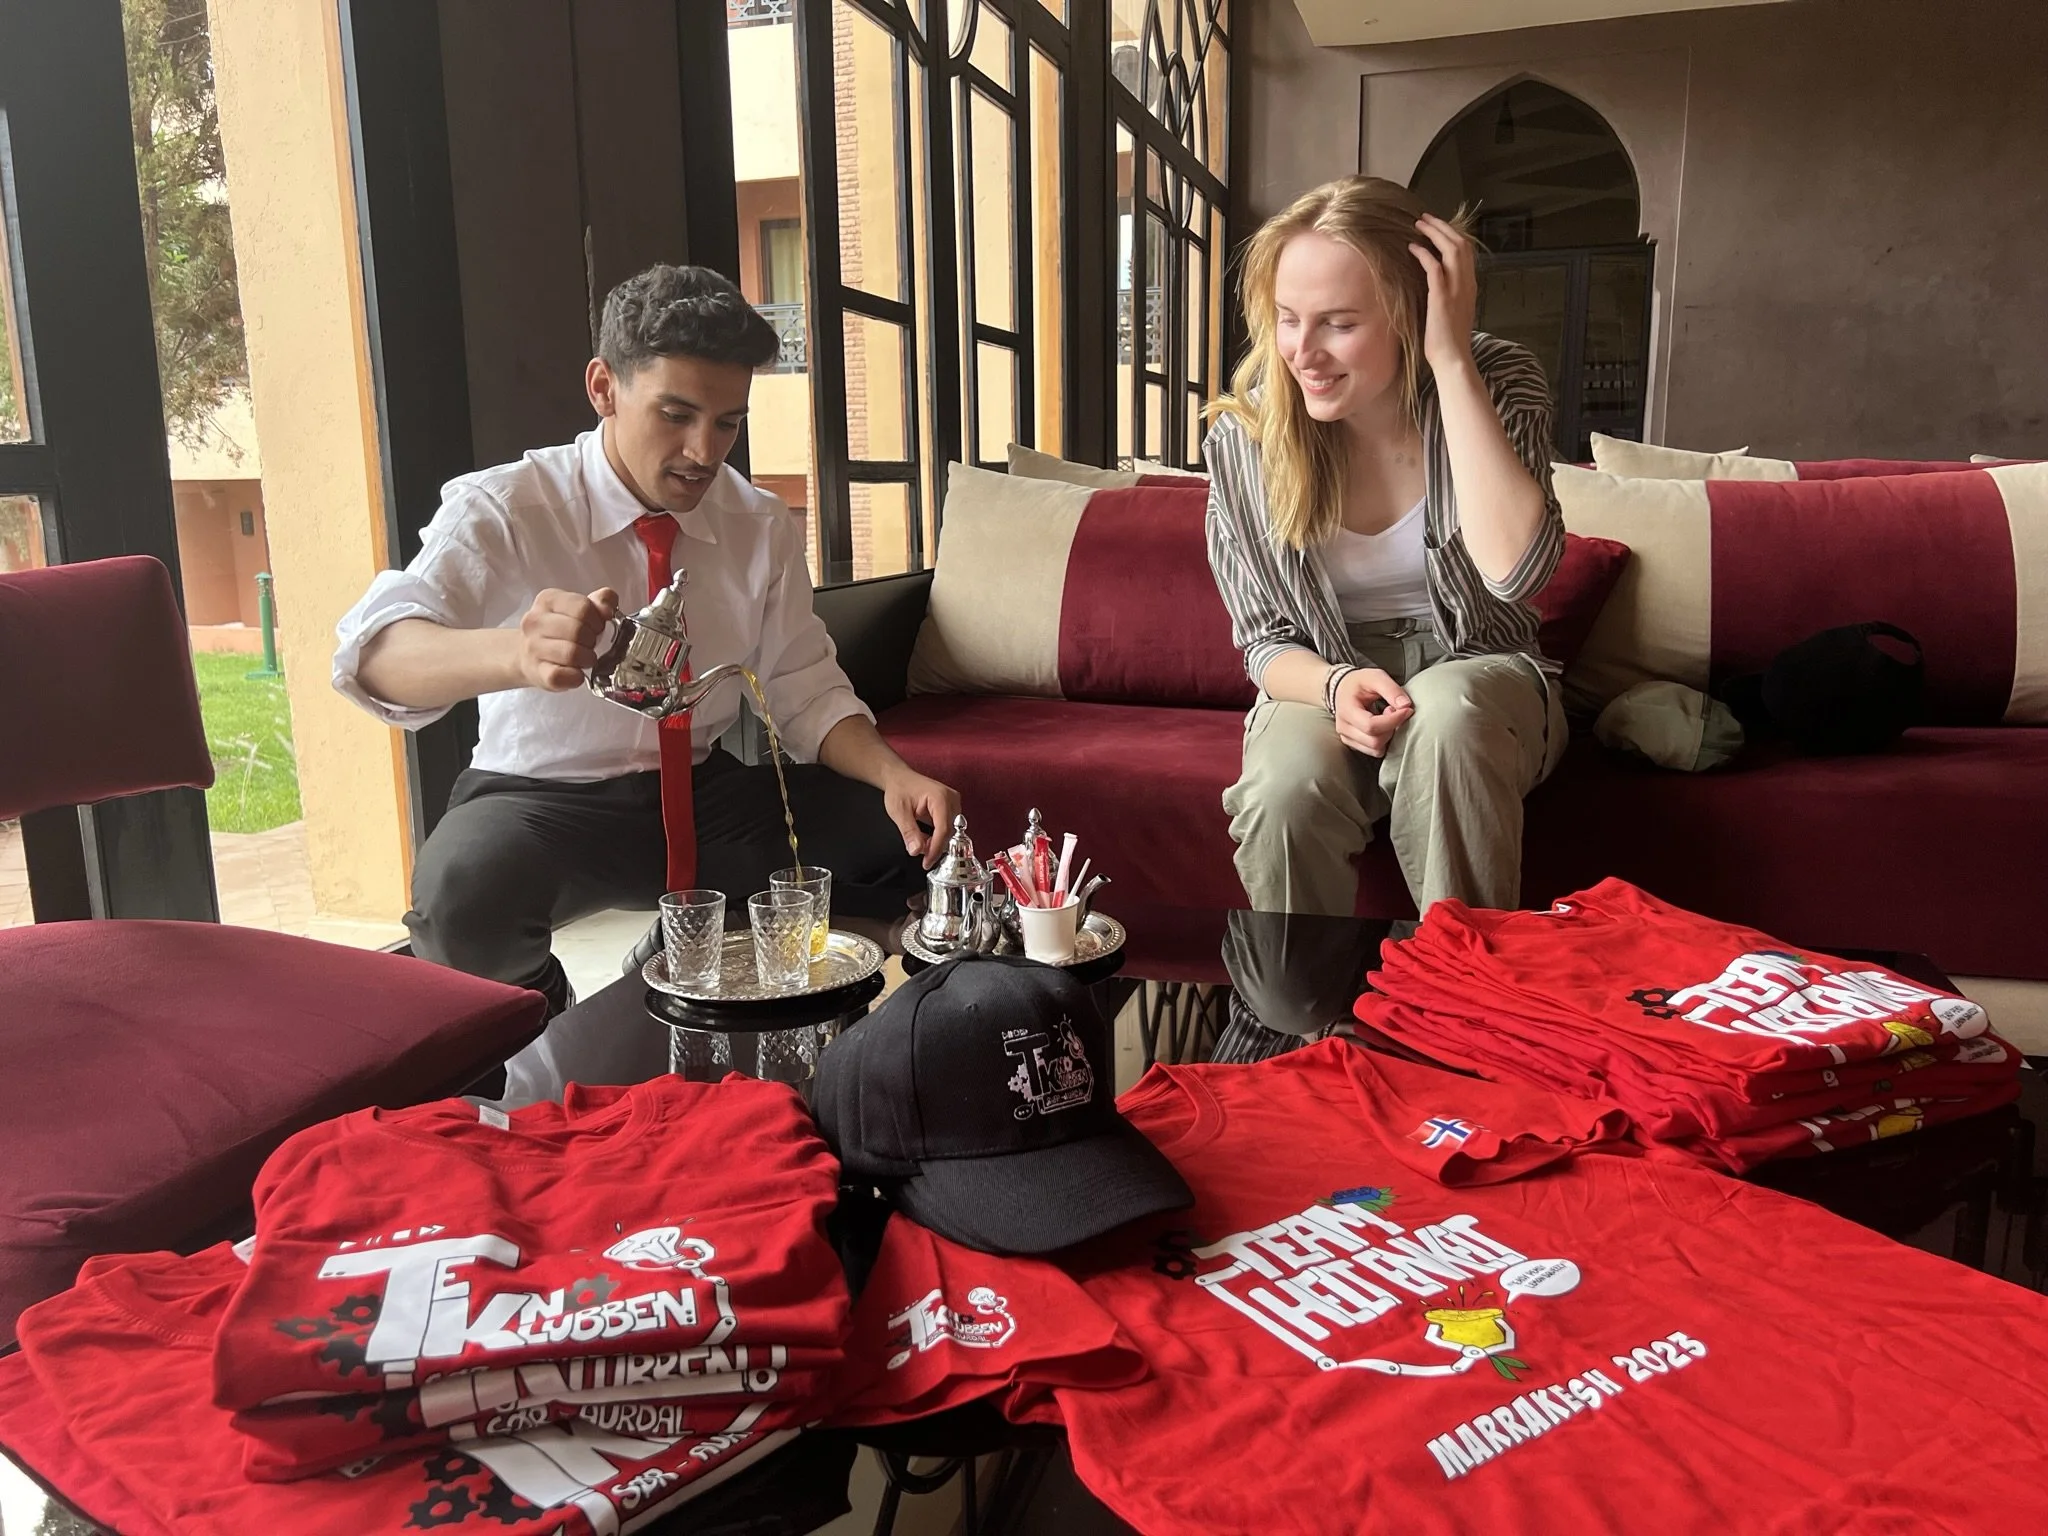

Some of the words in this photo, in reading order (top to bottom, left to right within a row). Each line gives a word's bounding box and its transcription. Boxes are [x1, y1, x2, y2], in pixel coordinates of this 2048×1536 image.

[1191, 1202, 1406, 1280] TEAM
[579, 1404, 695, 1435] AURDAL
[1425, 1368, 1624, 1480] MARRAKESH
[1611, 1330, 1707, 1383] 2023
